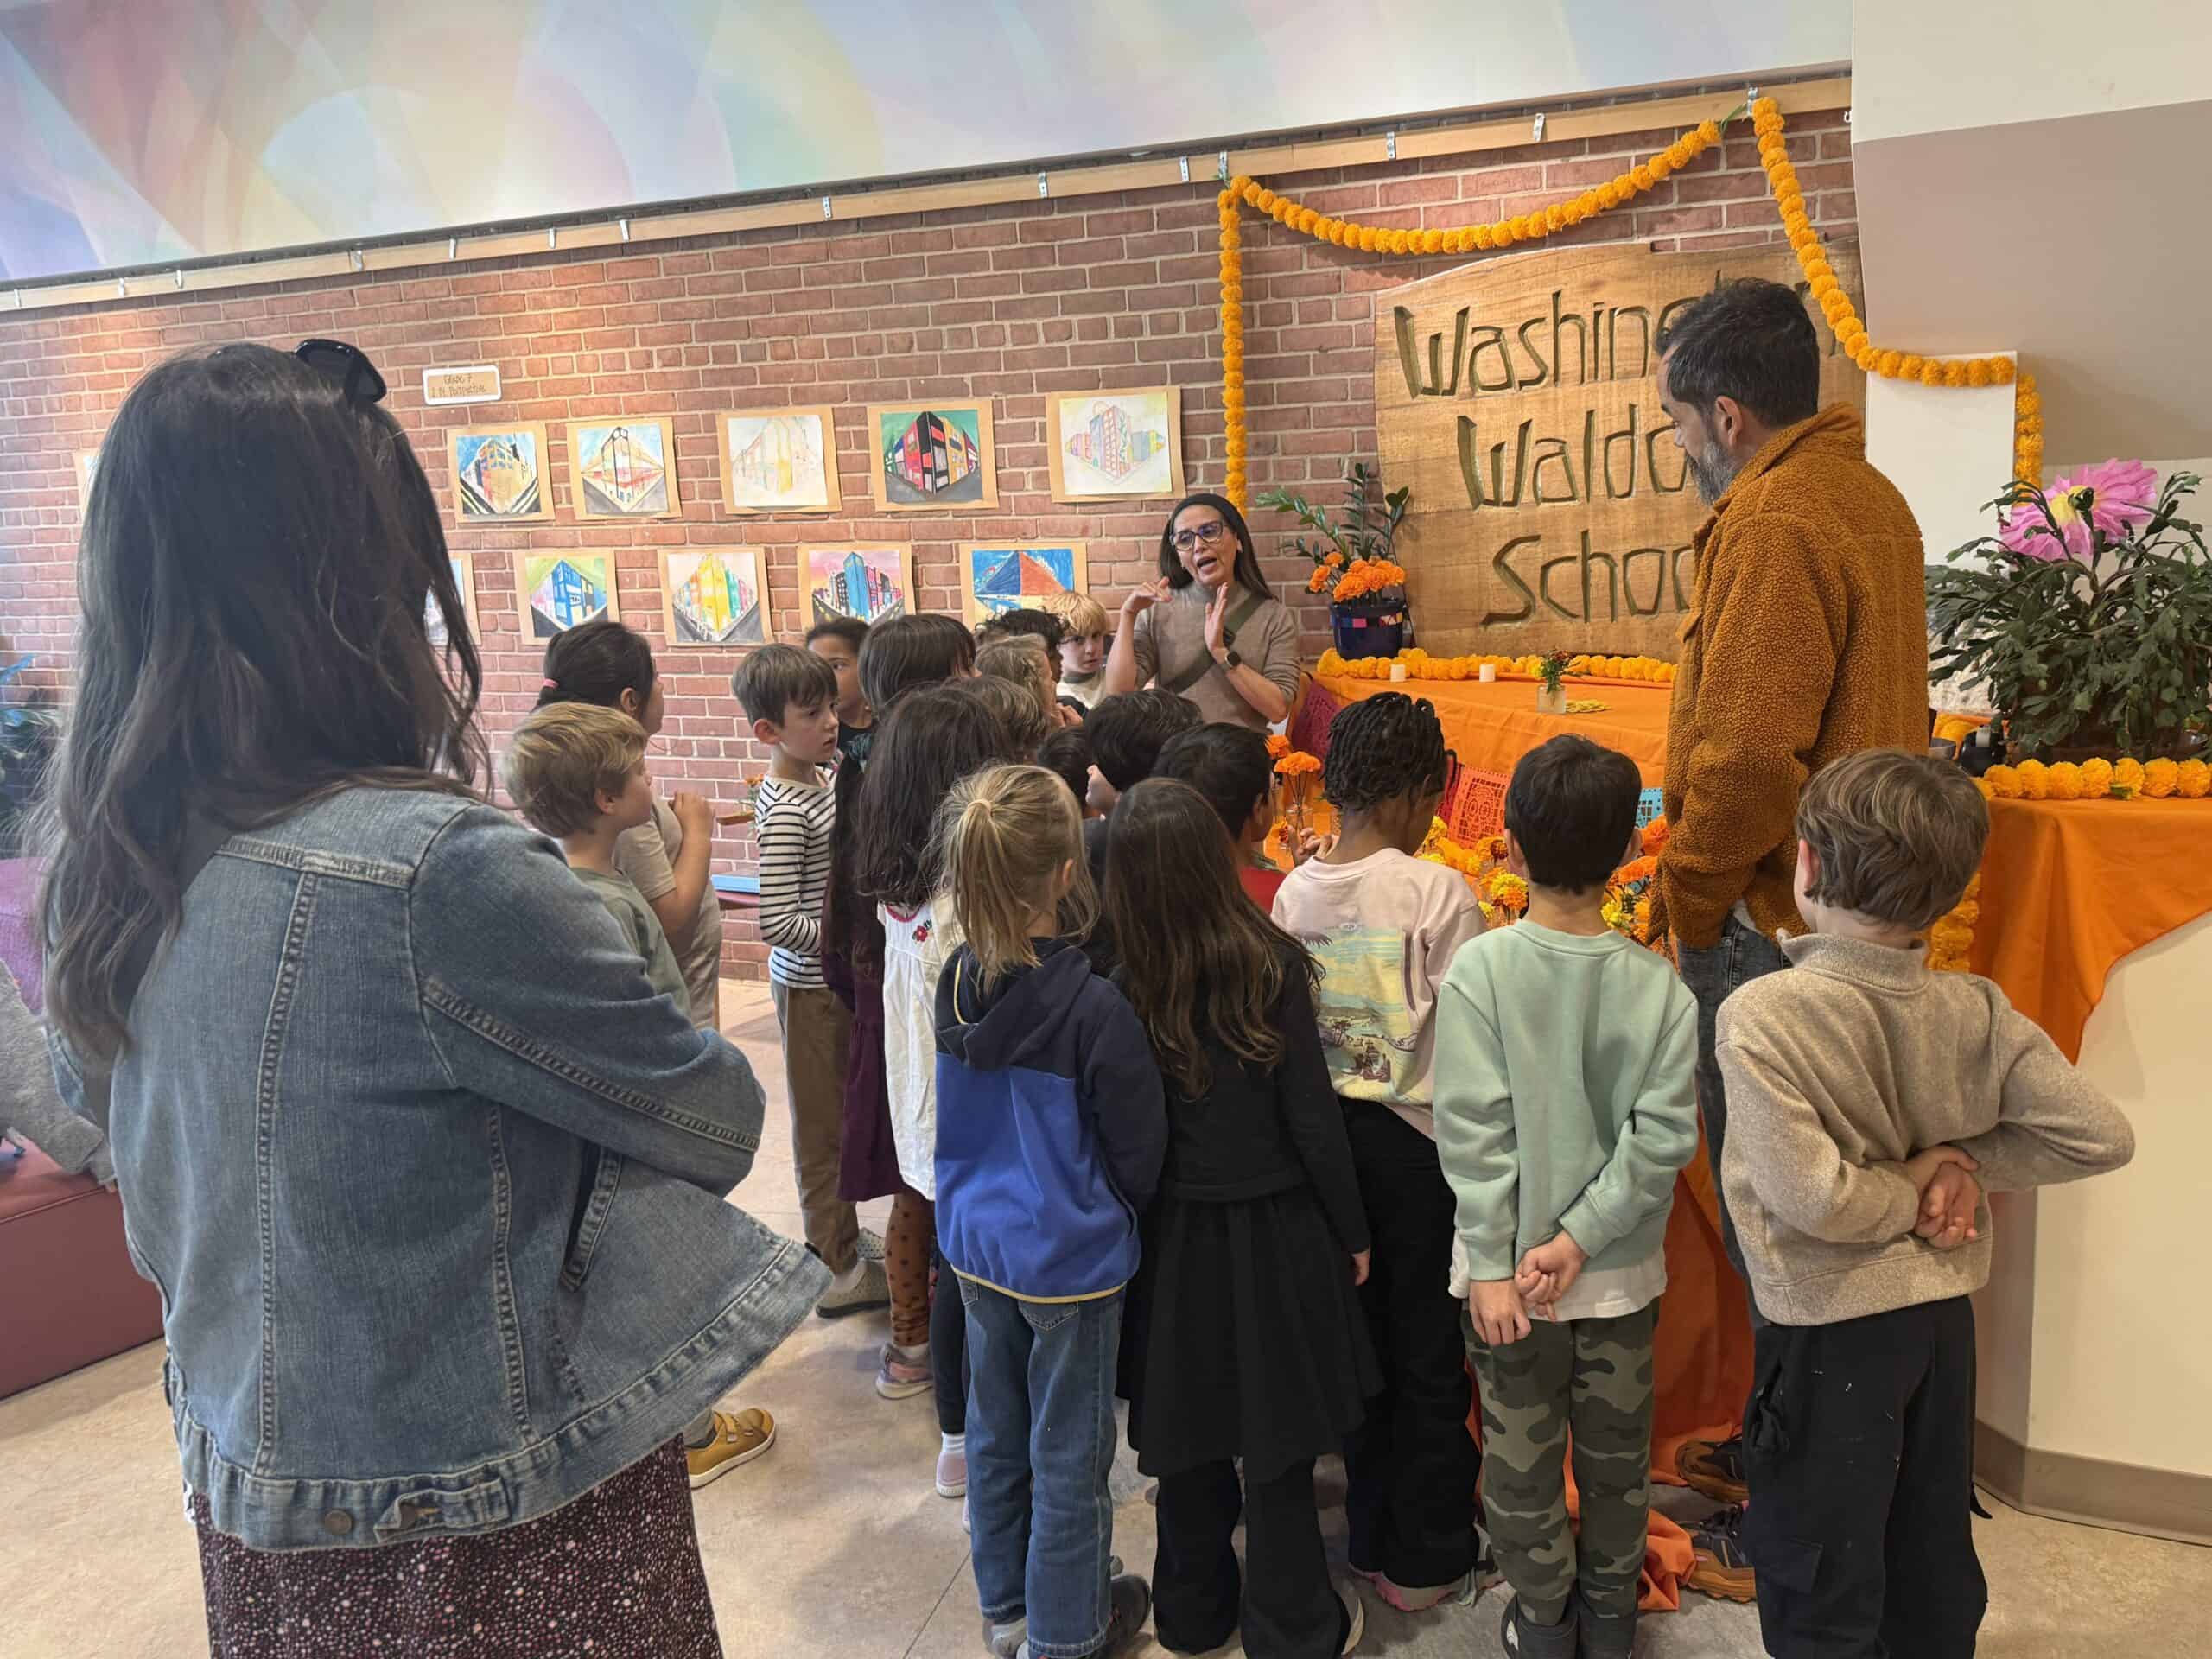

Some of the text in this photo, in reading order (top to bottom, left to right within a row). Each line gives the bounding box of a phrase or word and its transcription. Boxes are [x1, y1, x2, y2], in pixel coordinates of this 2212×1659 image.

[1392, 270, 1840, 397] Washin
[1455, 404, 1689, 512] Waldo
[1482, 530, 1694, 626] Schoo
